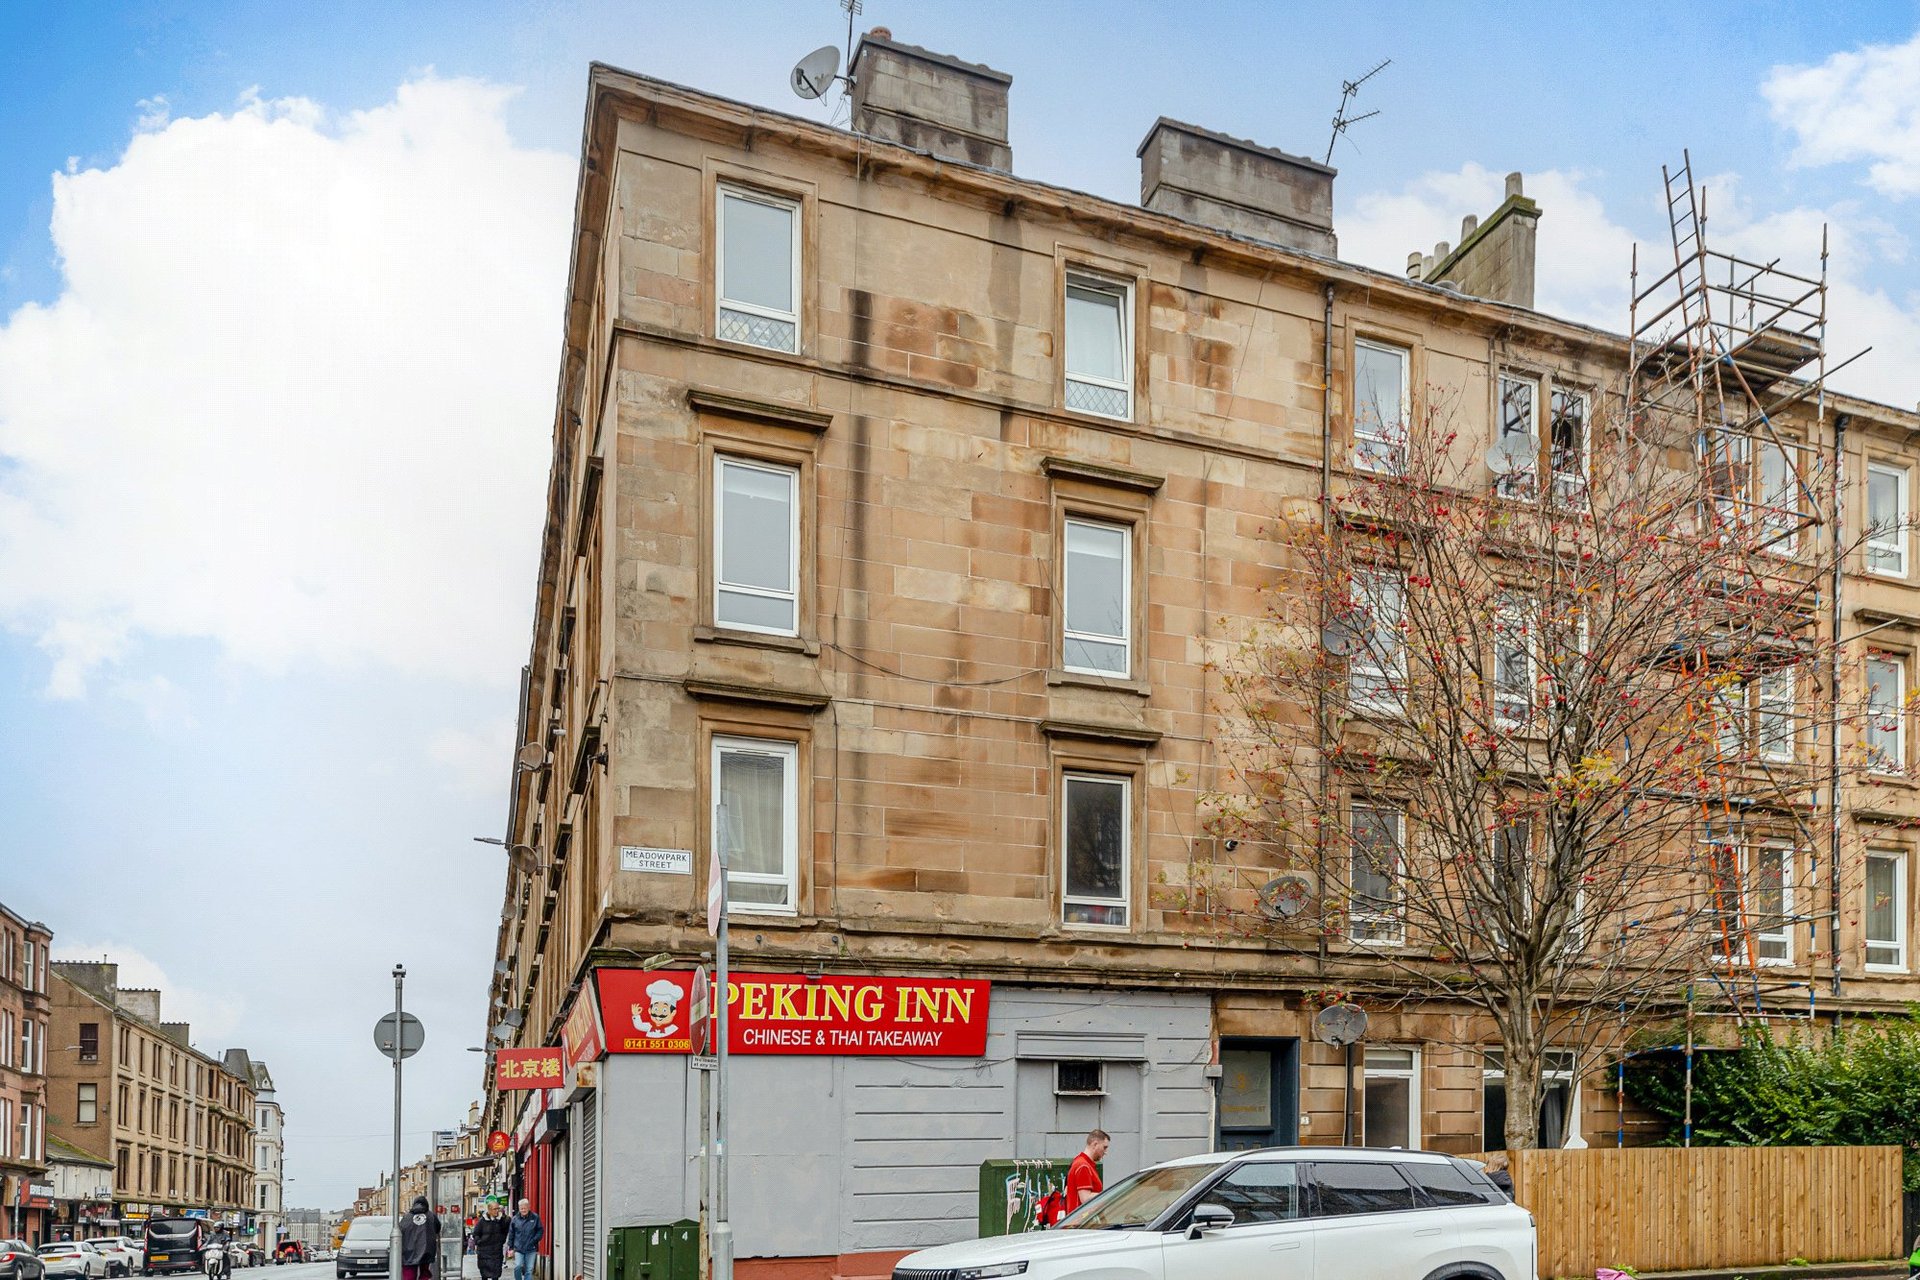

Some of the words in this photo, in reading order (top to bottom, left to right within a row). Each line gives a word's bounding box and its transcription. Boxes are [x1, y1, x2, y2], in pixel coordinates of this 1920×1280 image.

[625, 851, 687, 862] MEADOWPARK
[639, 860, 672, 869] STREET
[709, 982, 885, 1022] PEKING
[894, 986, 975, 1024] INN
[743, 1028, 811, 1046] CHINESE
[815, 1029, 826, 1046] &
[829, 1030, 862, 1046] THAI
[866, 1030, 943, 1046] TAKEAWAY
[625, 1040, 647, 1049] 0141
[650, 1040, 665, 1049] 551
[668, 1040, 689, 1049] 0306
